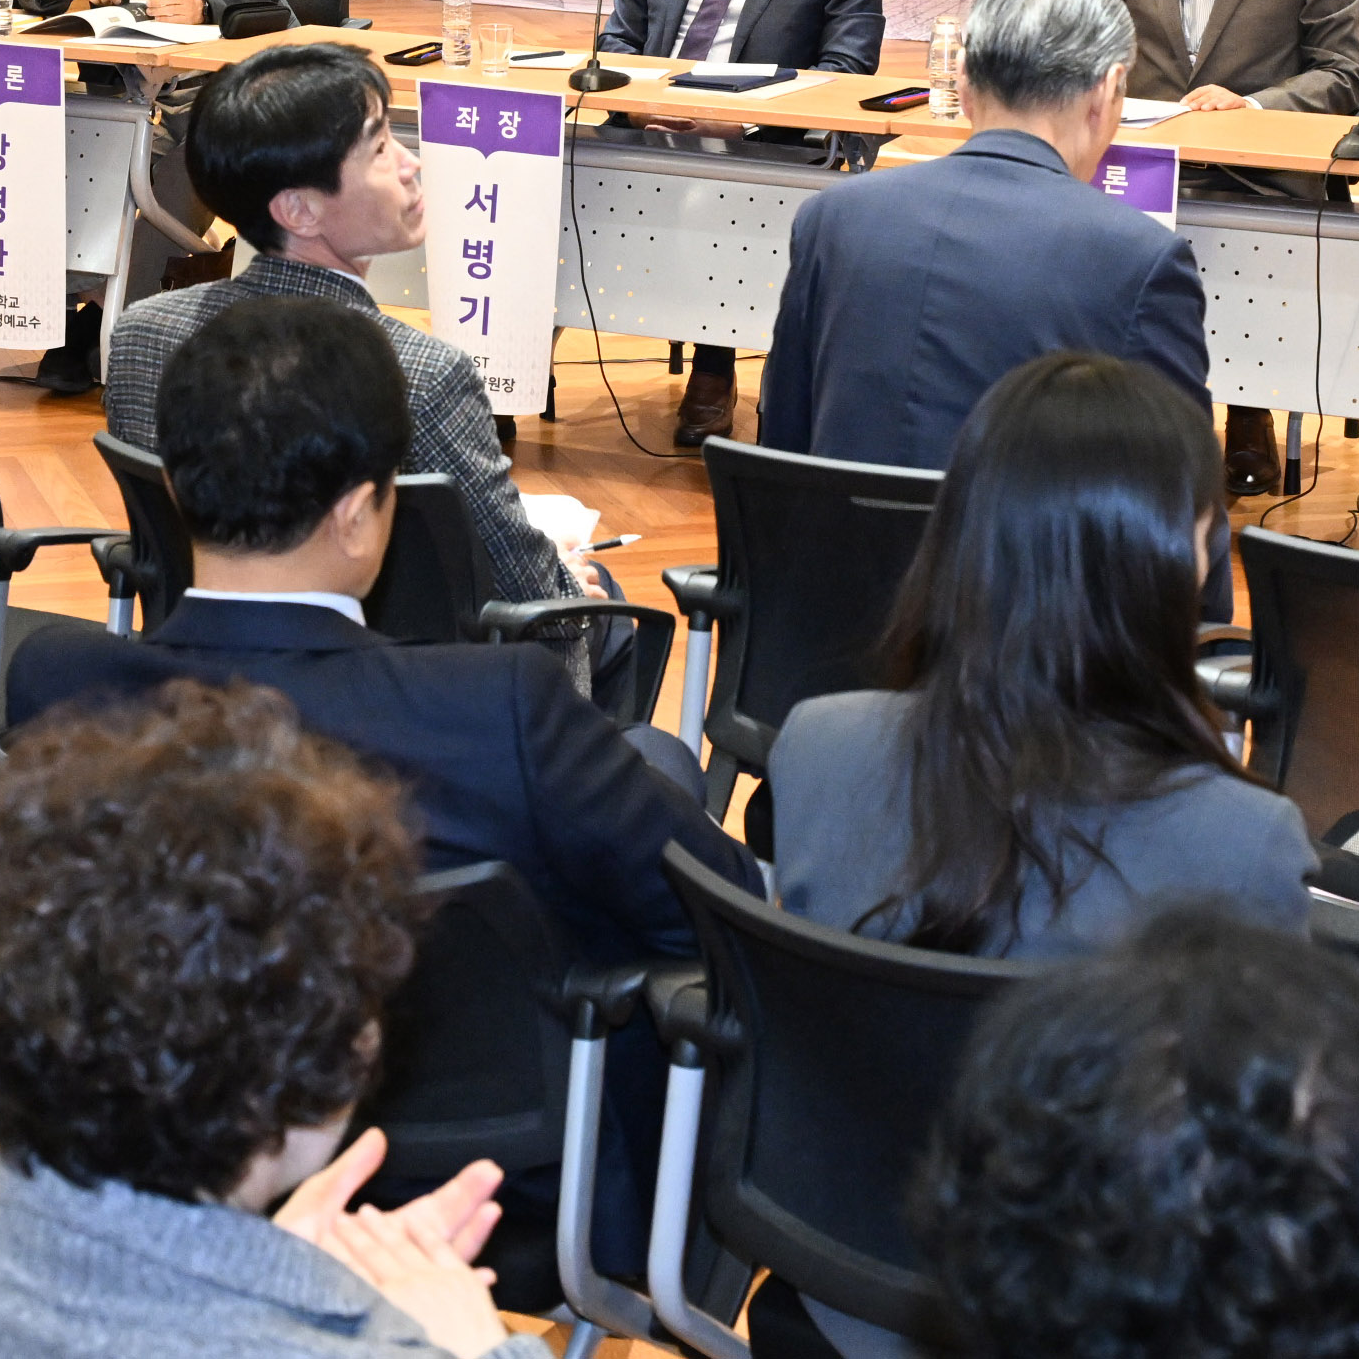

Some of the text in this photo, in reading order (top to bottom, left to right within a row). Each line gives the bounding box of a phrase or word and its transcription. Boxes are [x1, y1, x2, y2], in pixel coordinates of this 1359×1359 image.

[1102, 164, 1129, 195] 론
[457, 182, 499, 337] 서병기
[483, 375, 516, 393] 원장
